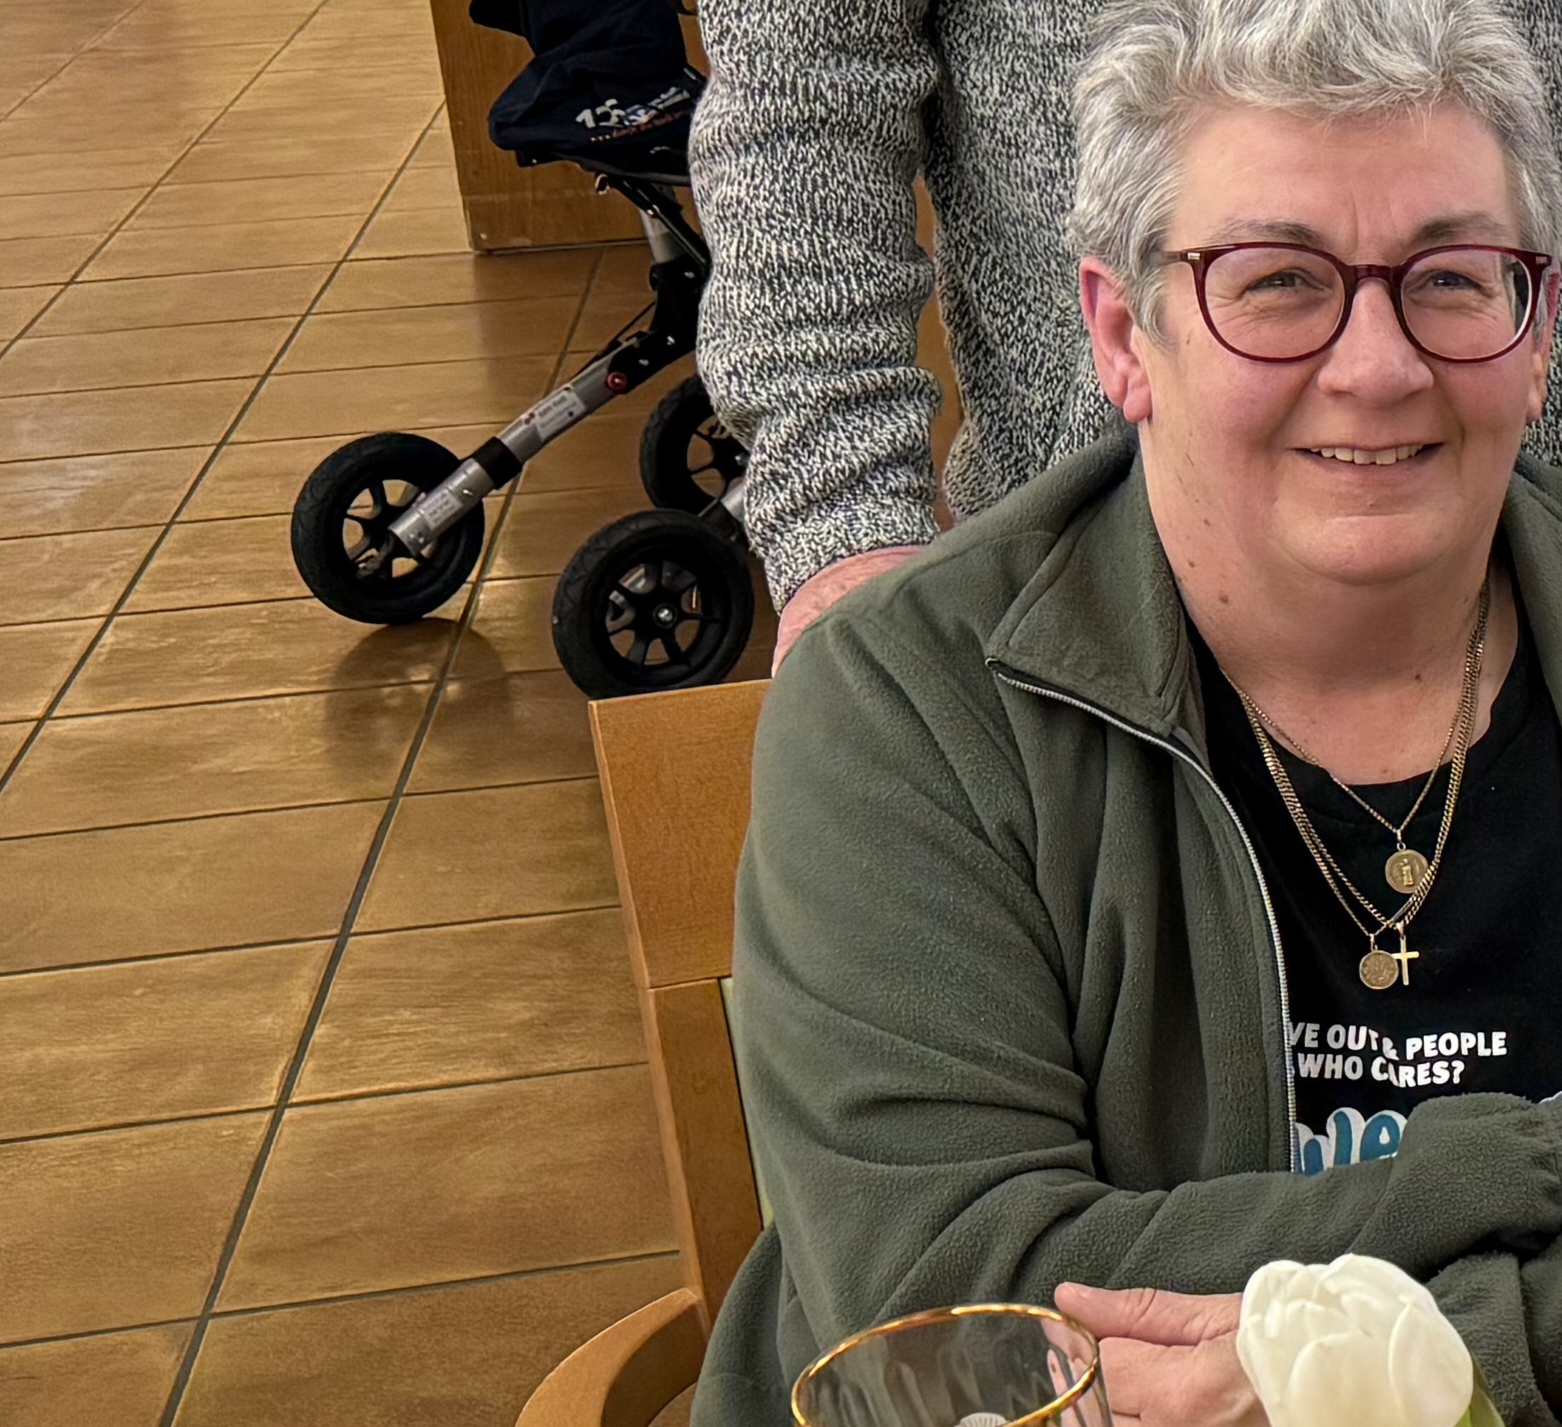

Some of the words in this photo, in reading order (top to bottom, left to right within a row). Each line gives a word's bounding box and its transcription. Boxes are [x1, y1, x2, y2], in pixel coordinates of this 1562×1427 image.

[1327, 1024, 1379, 1050] OUT
[1406, 1031, 1507, 1060] PEOPLE
[1298, 1053, 1363, 1080] WHO
